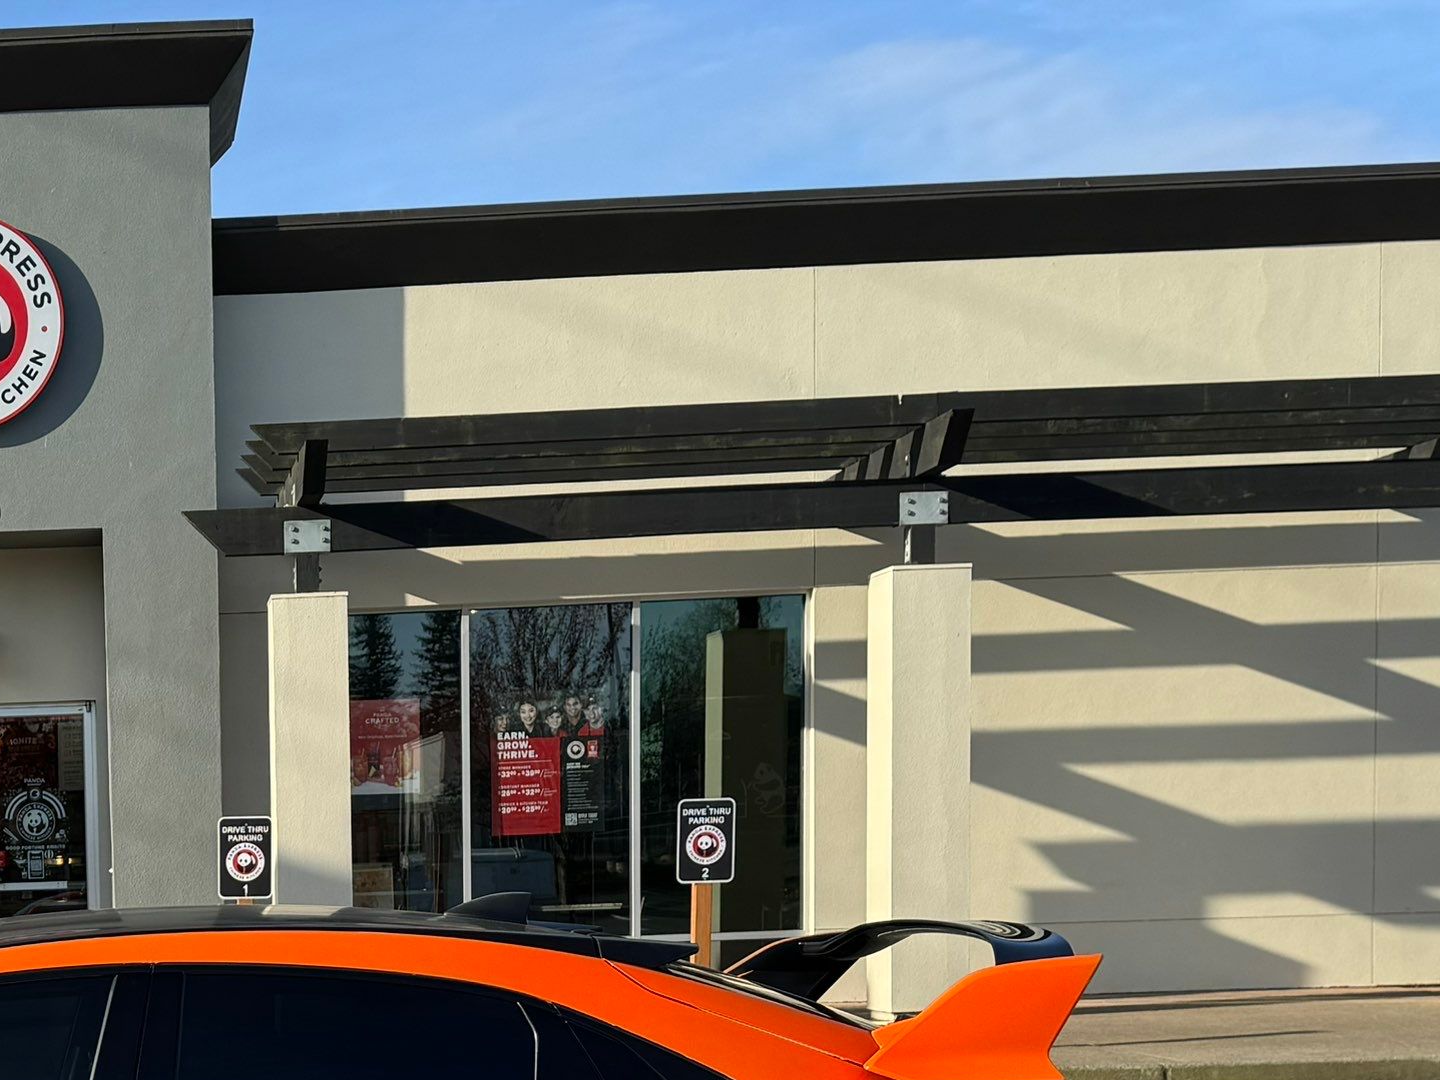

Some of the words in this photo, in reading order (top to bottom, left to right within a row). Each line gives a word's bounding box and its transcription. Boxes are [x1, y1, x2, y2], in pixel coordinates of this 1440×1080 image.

[497, 731, 529, 740] EARN.
[497, 740, 532, 750] GROW.
[497, 750, 538, 760] THRIVE.
[682, 808, 707, 816] DRIVE
[688, 816, 725, 824] PARKING
[702, 868, 709, 878] 2
[243, 884, 248, 896] 1
